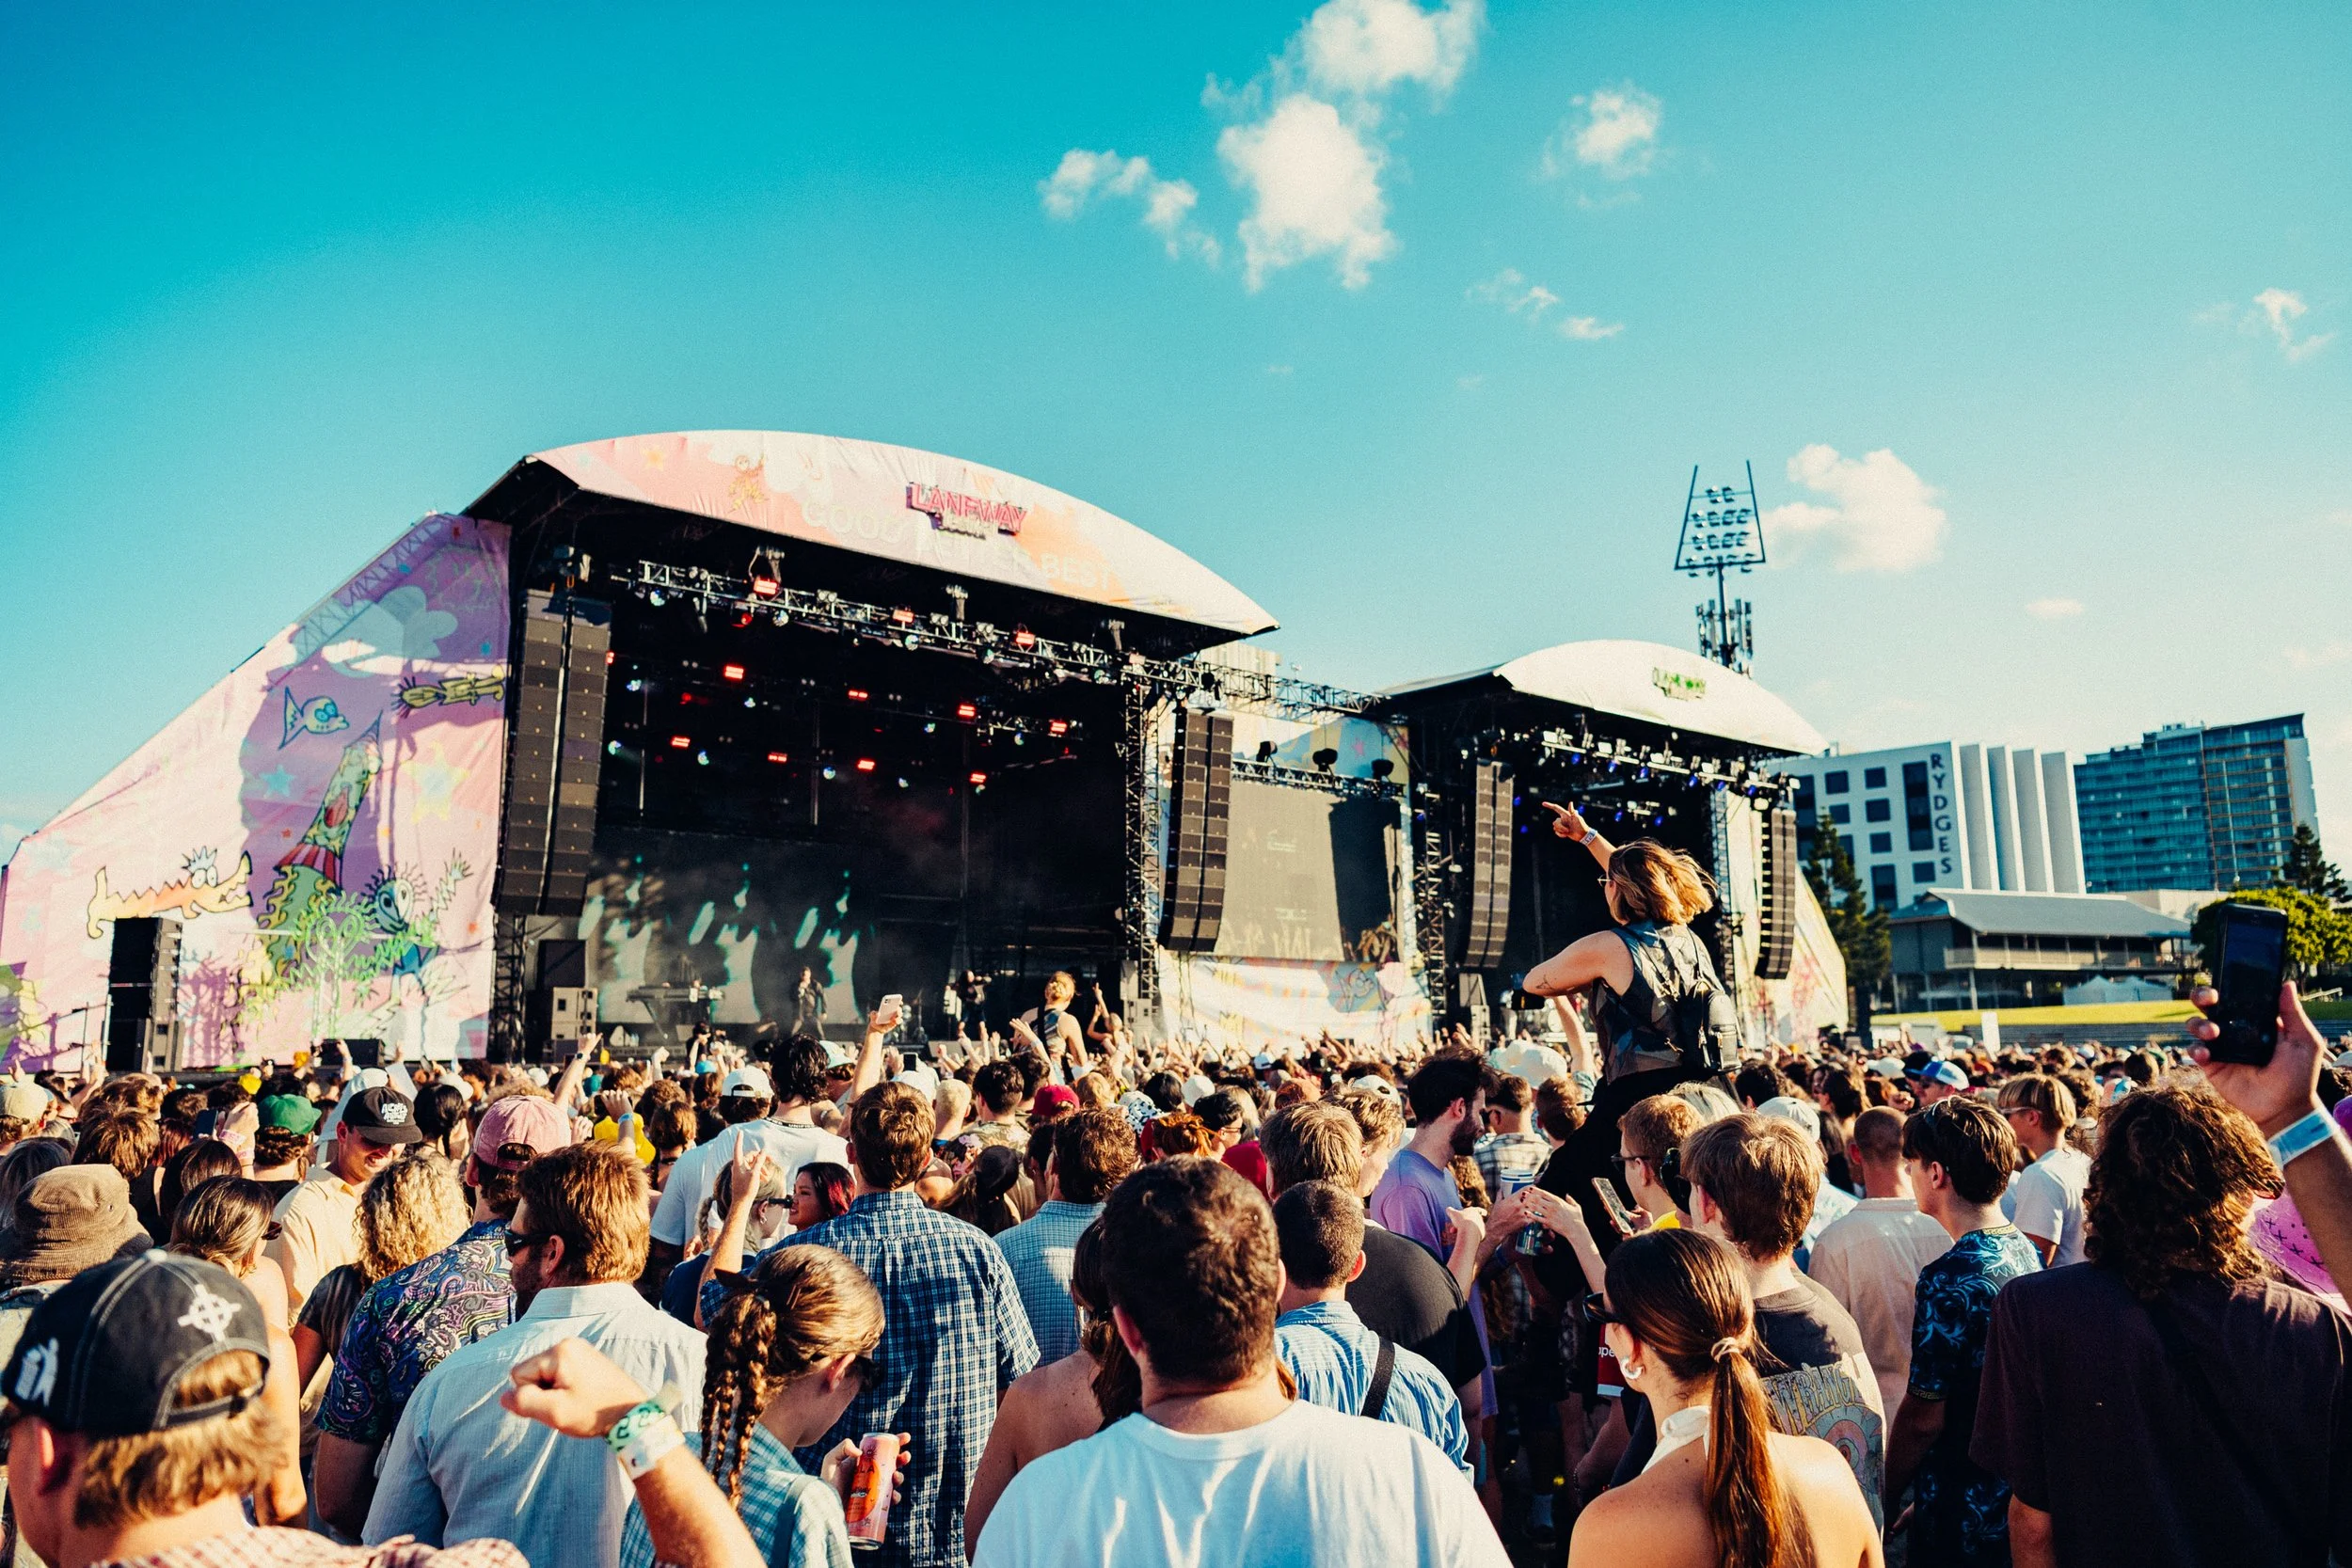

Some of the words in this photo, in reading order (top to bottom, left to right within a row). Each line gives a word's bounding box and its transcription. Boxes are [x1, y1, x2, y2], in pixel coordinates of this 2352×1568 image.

[802, 499, 903, 545] GOOD
[1040, 551, 1113, 591] BEST
[1931, 753, 1952, 874] RYDGES
